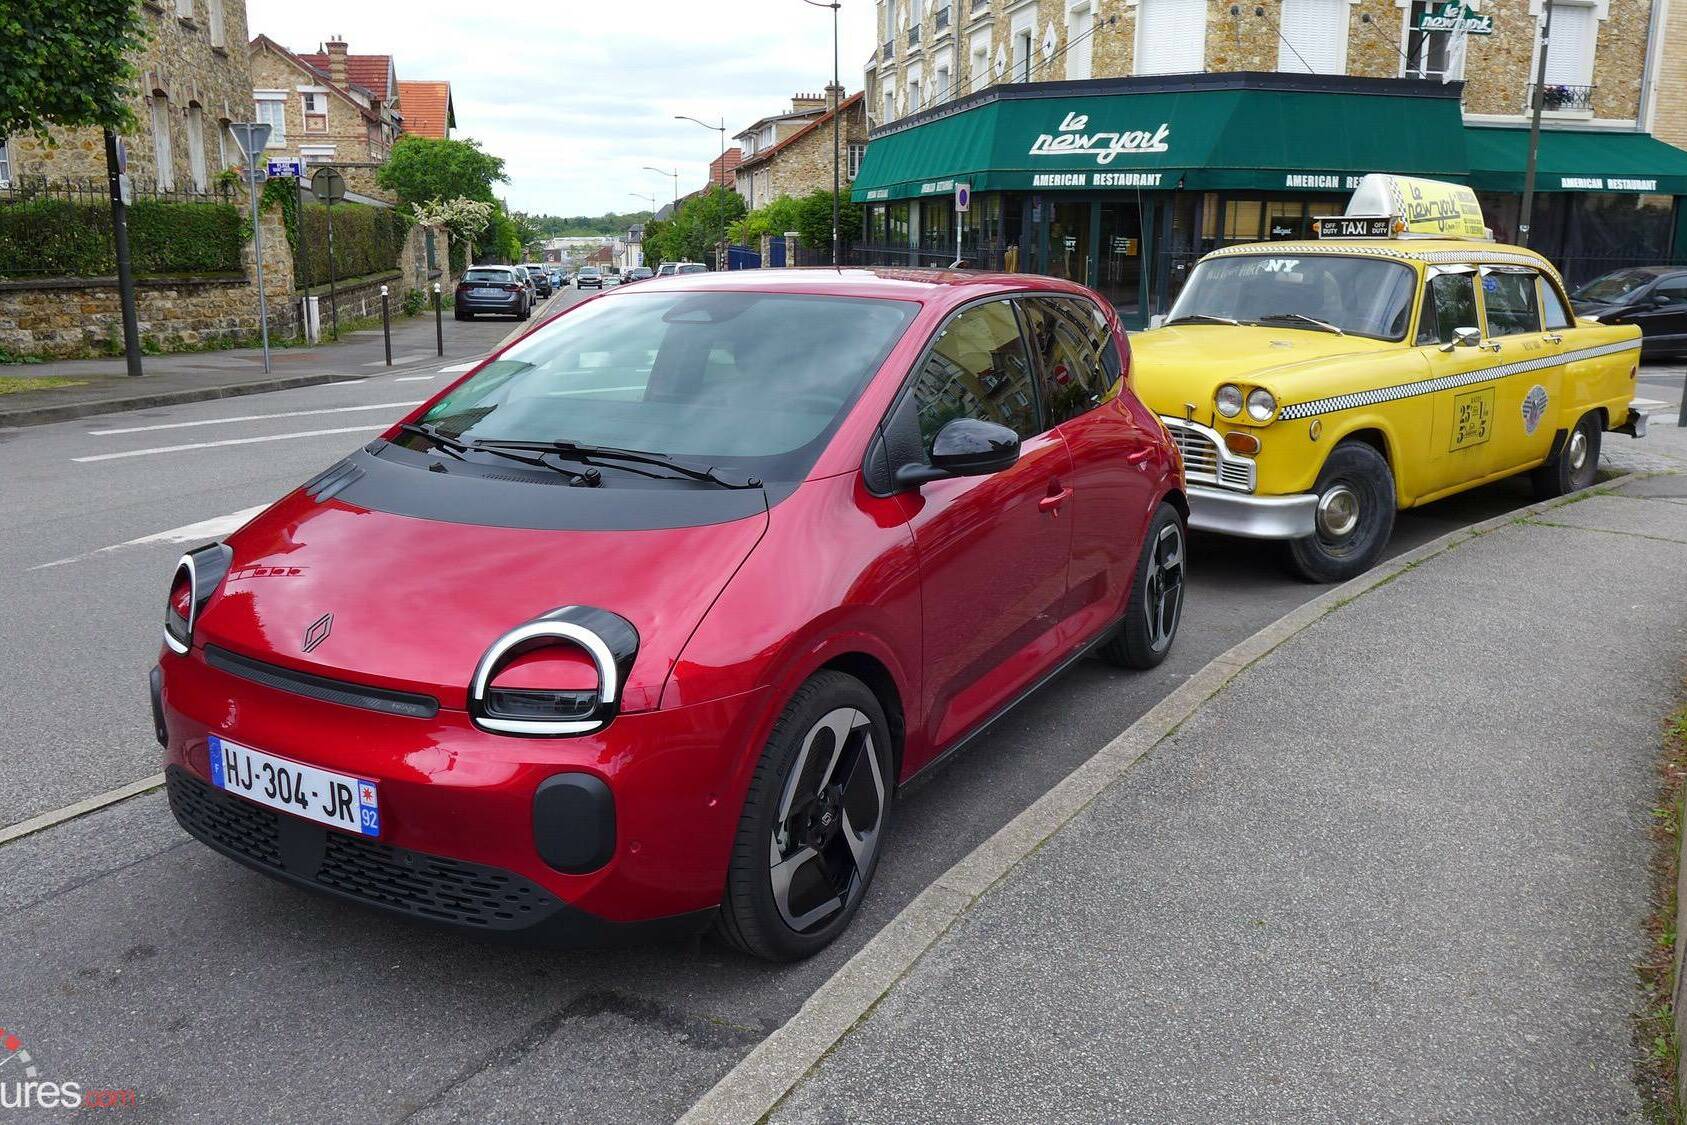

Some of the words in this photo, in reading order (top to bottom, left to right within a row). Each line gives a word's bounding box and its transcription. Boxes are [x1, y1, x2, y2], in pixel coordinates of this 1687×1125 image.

[1033, 174, 1086, 187] AMERICAN
[1093, 173, 1162, 186] RESTAURANT
[1286, 174, 1340, 188] AMERICAN
[1561, 177, 1603, 189] AMERICAN
[1607, 179, 1657, 191] RESTAURANT
[1341, 221, 1367, 235] TAXI
[1264, 259, 1300, 273] NY
[225, 748, 355, 824] HJ-304-JR
[361, 808, 380, 830] 92
